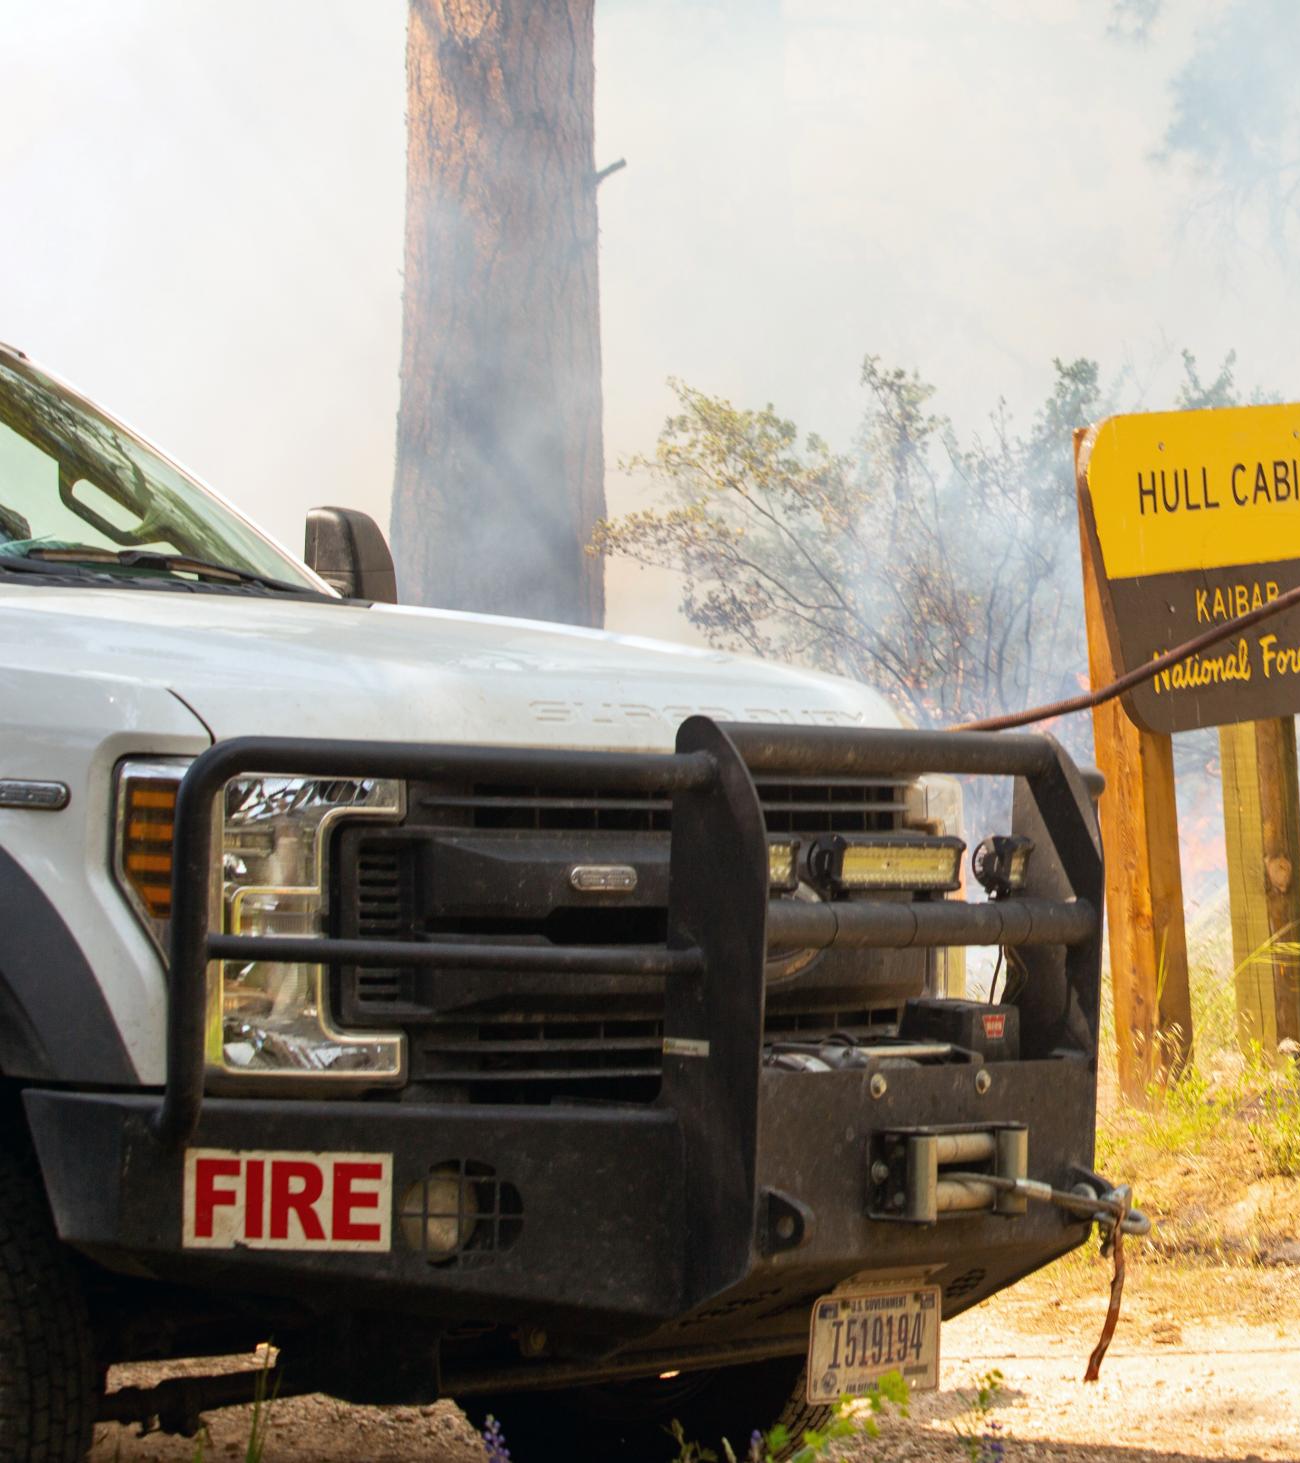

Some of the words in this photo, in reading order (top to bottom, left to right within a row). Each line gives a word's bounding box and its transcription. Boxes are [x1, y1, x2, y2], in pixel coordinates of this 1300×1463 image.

[1137, 466, 1220, 515] HULL
[1153, 638, 1252, 694] National
[194, 1158, 383, 1242] FIRE
[828, 1312, 923, 1370] I519194
